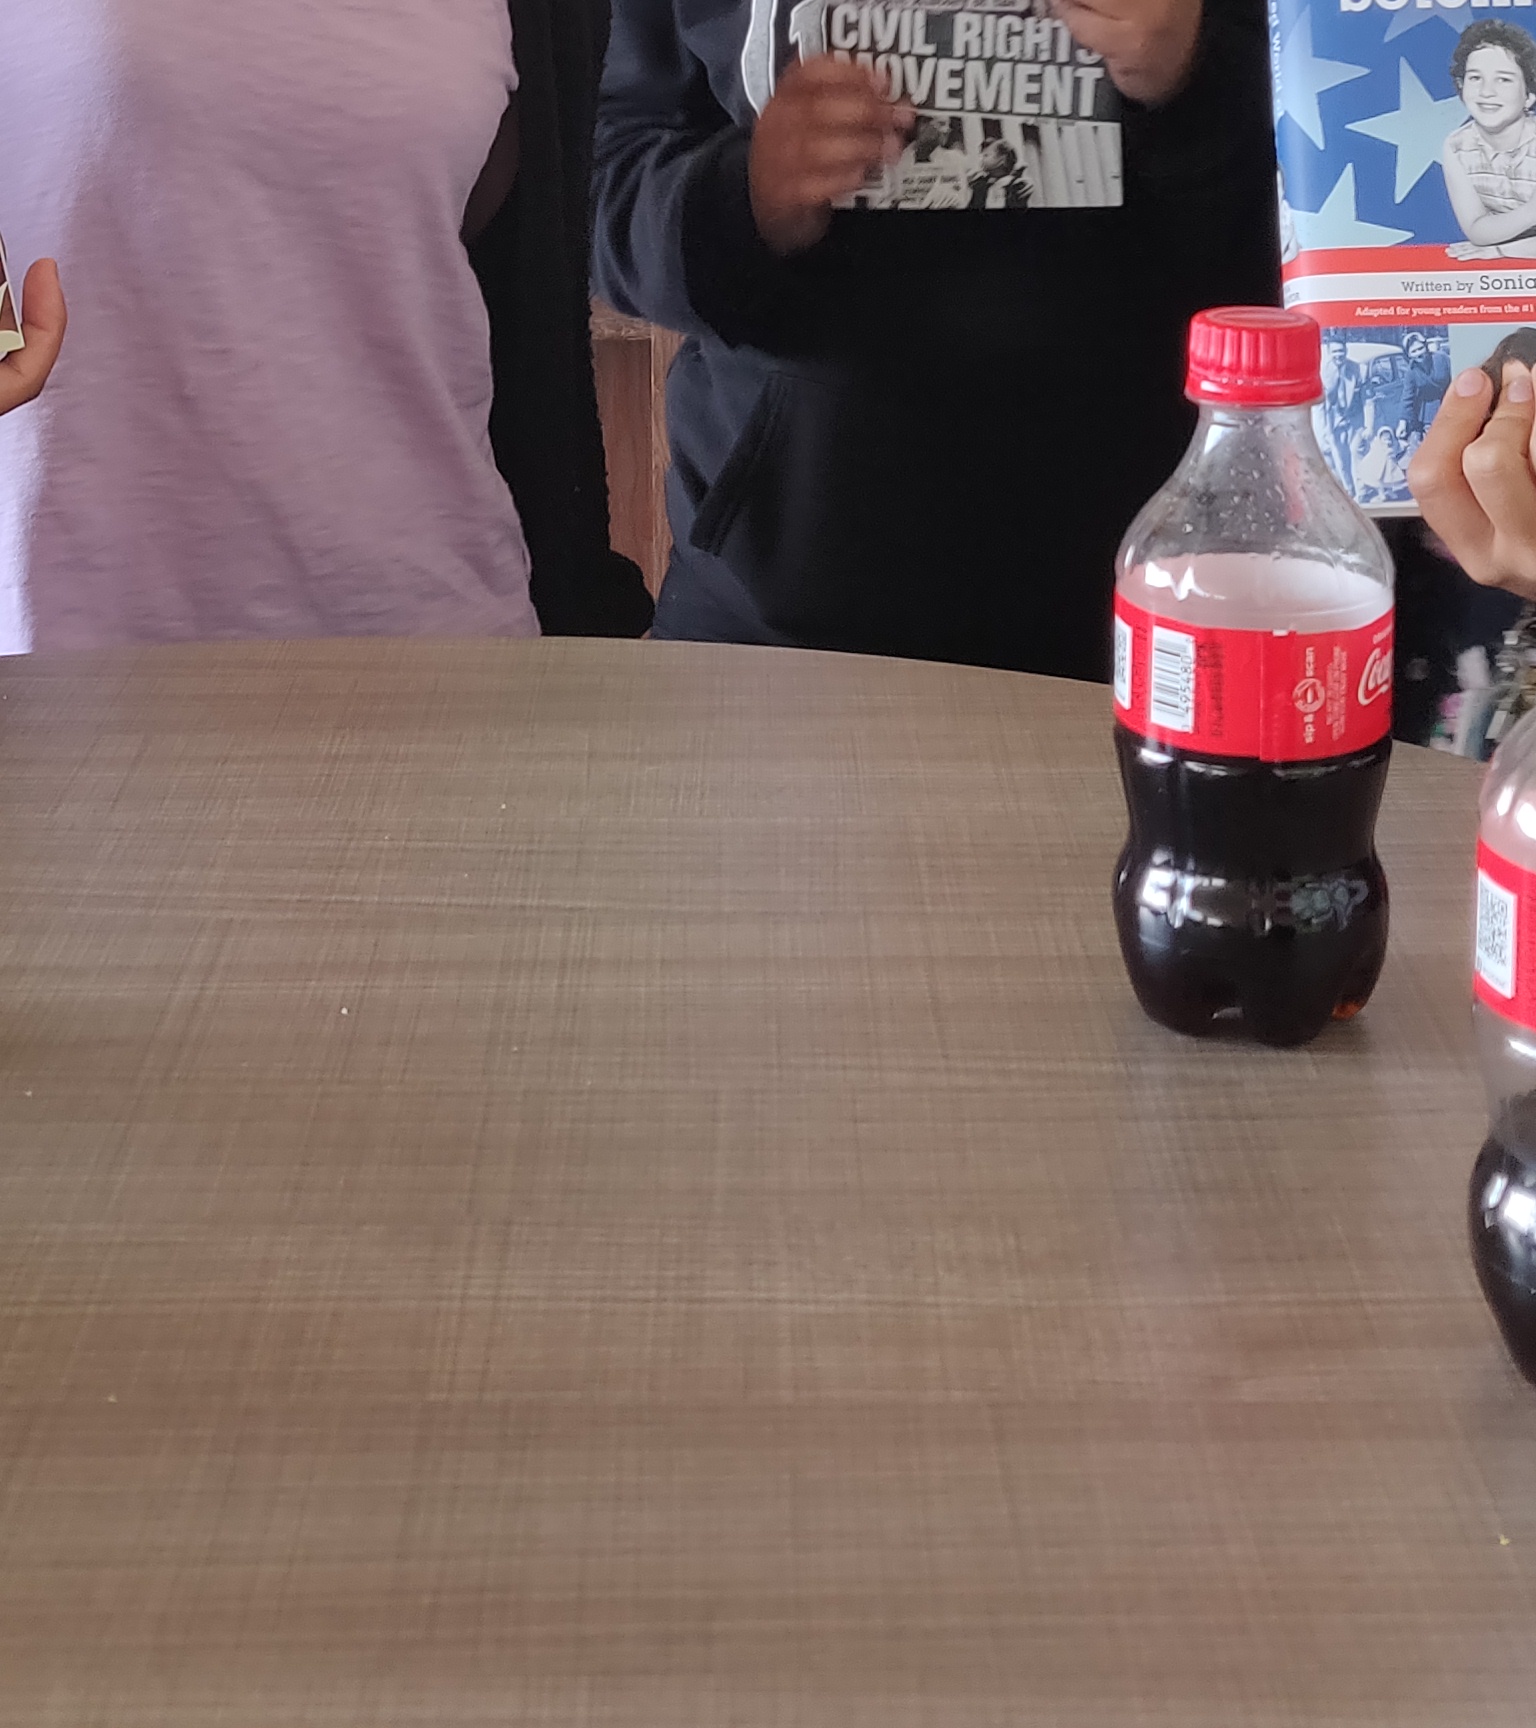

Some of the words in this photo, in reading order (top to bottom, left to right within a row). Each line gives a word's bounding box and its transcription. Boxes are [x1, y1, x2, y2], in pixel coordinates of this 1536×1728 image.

[830, 3, 937, 57] CIVIL
[952, 11, 1104, 66] RIGHT
[834, 50, 1104, 117] OVEMENT
[1401, 280, 1452, 292] Written
[1456, 280, 1474, 294] by
[1355, 306, 1395, 318] Adapted
[1396, 306, 1410, 316] for
[1412, 306, 1442, 317] young
[1443, 305, 1478, 315] readers
[1480, 304, 1502, 314] from
[1504, 303, 1520, 313] the
